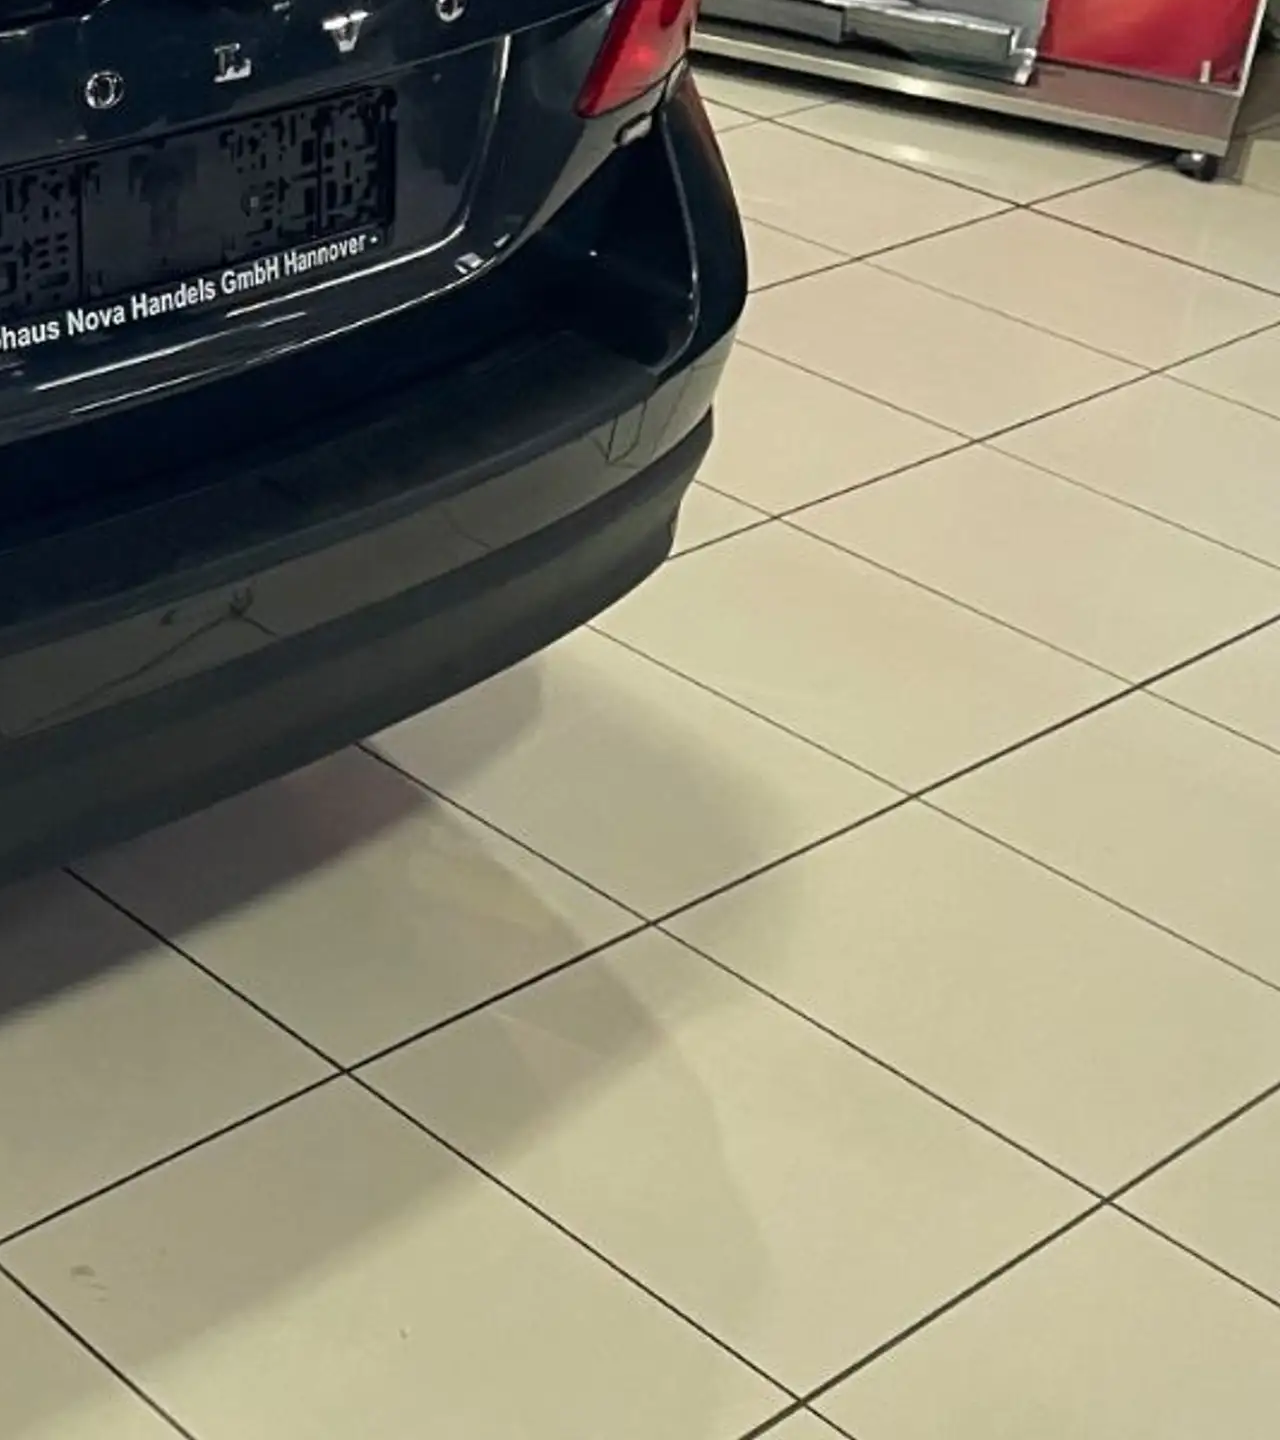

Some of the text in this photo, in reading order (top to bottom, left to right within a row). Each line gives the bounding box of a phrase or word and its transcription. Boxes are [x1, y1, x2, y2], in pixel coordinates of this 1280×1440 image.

[66, 305, 126, 336] Nova
[130, 278, 216, 320] Handels
[220, 256, 280, 294] GmbH
[284, 234, 367, 275] Hannover
